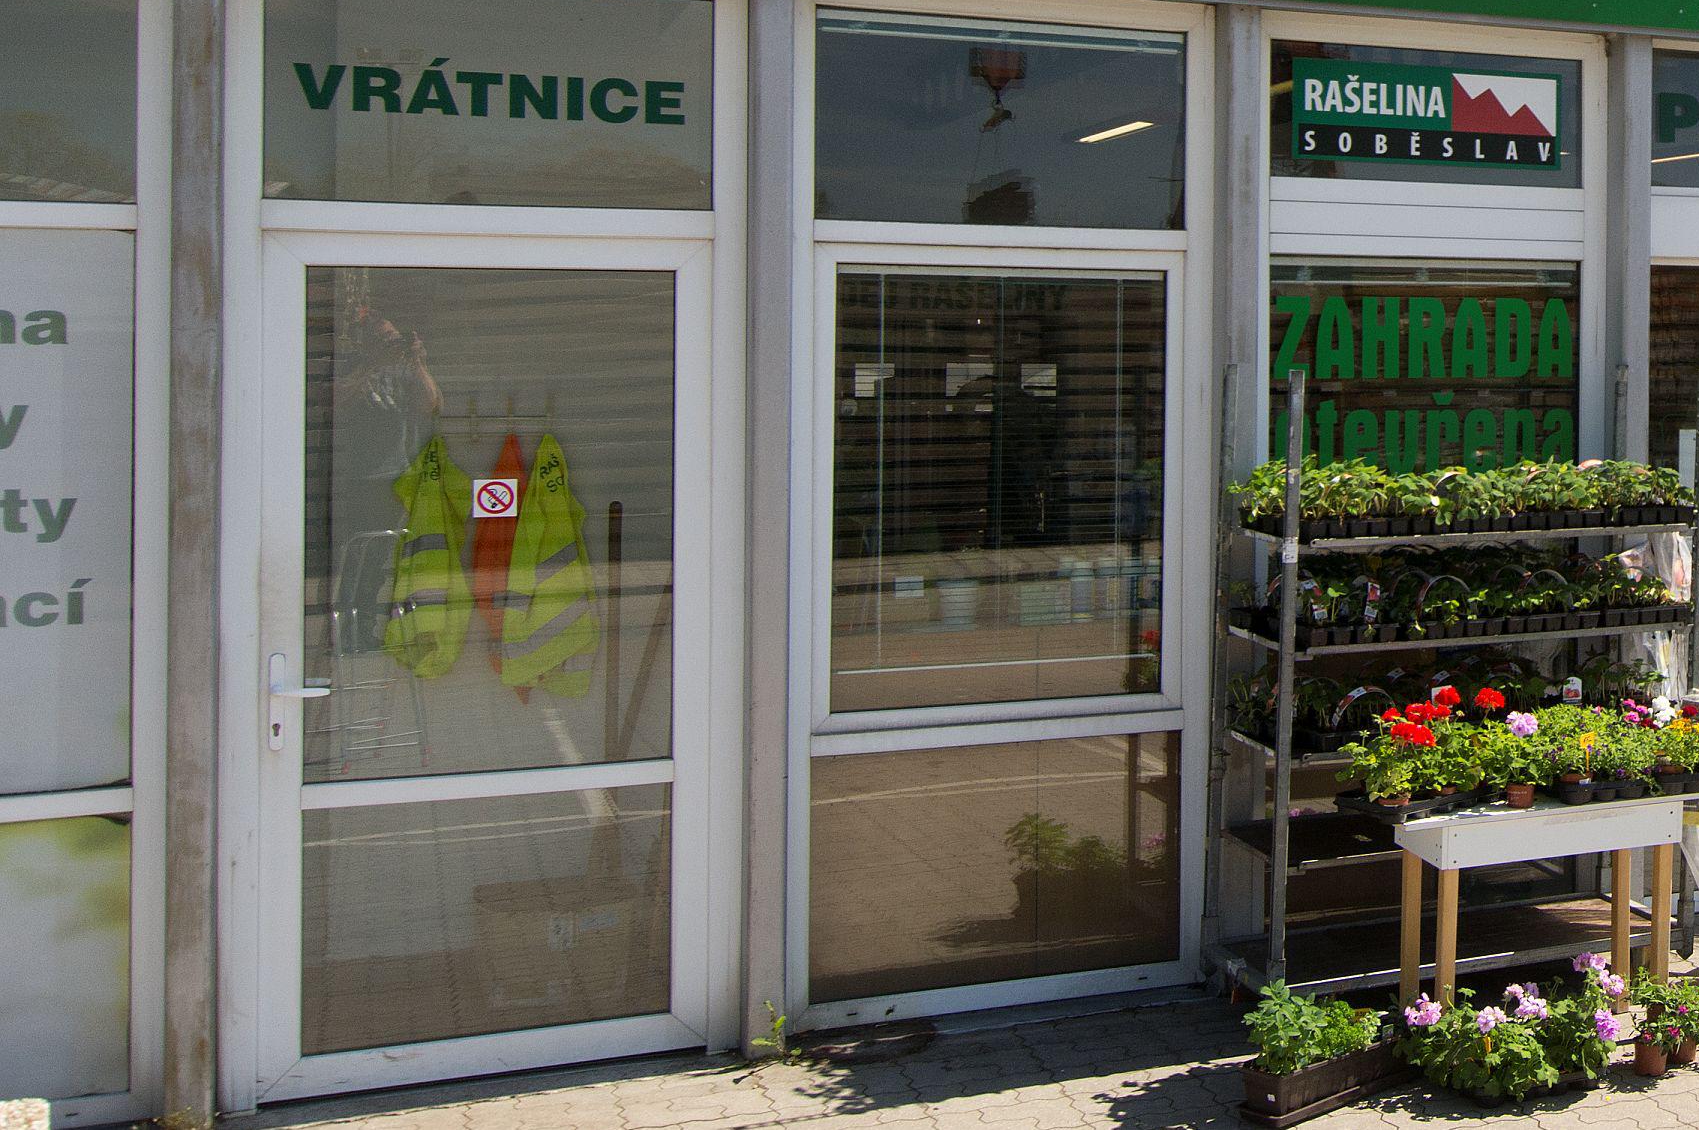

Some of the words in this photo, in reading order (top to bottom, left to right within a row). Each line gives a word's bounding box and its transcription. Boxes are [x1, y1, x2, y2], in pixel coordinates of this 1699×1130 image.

[293, 58, 686, 125] VRÁTNICE
[1303, 74, 1446, 118] RAŠELINA
[1274, 296, 1575, 379] ZAHRADA
[0, 578, 93, 628] cí
